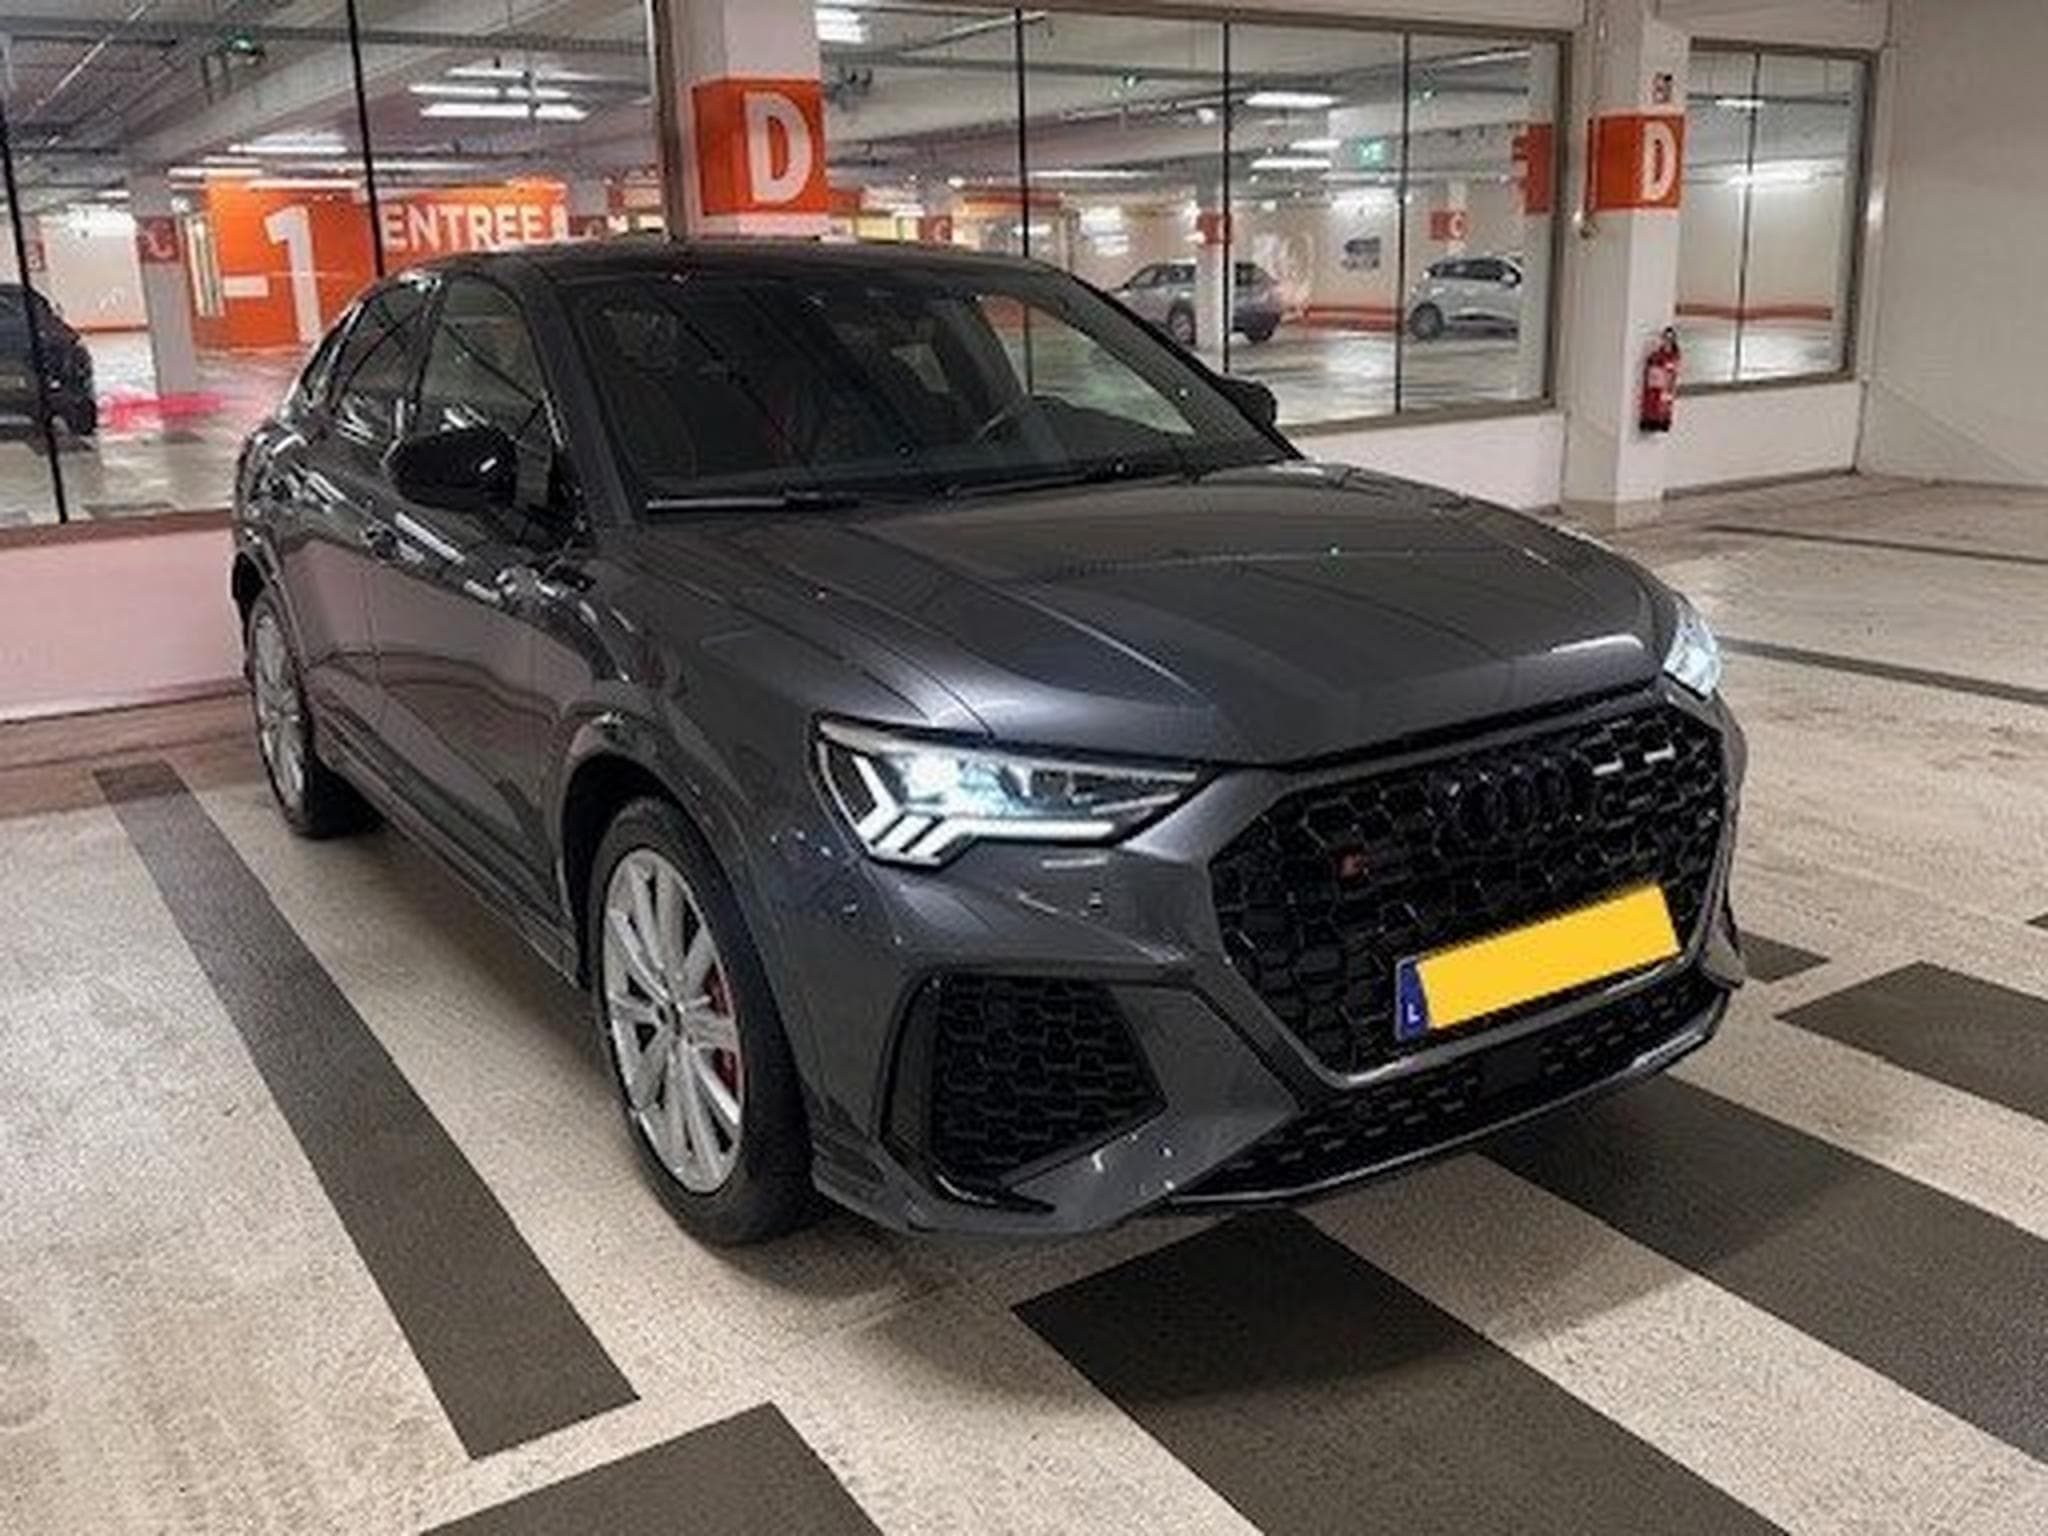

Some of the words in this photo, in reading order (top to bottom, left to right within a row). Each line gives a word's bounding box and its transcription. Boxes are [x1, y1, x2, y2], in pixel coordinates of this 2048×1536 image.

[744, 90, 812, 202] D
[1642, 120, 1676, 200] D
[382, 203, 548, 250] ENTREE
